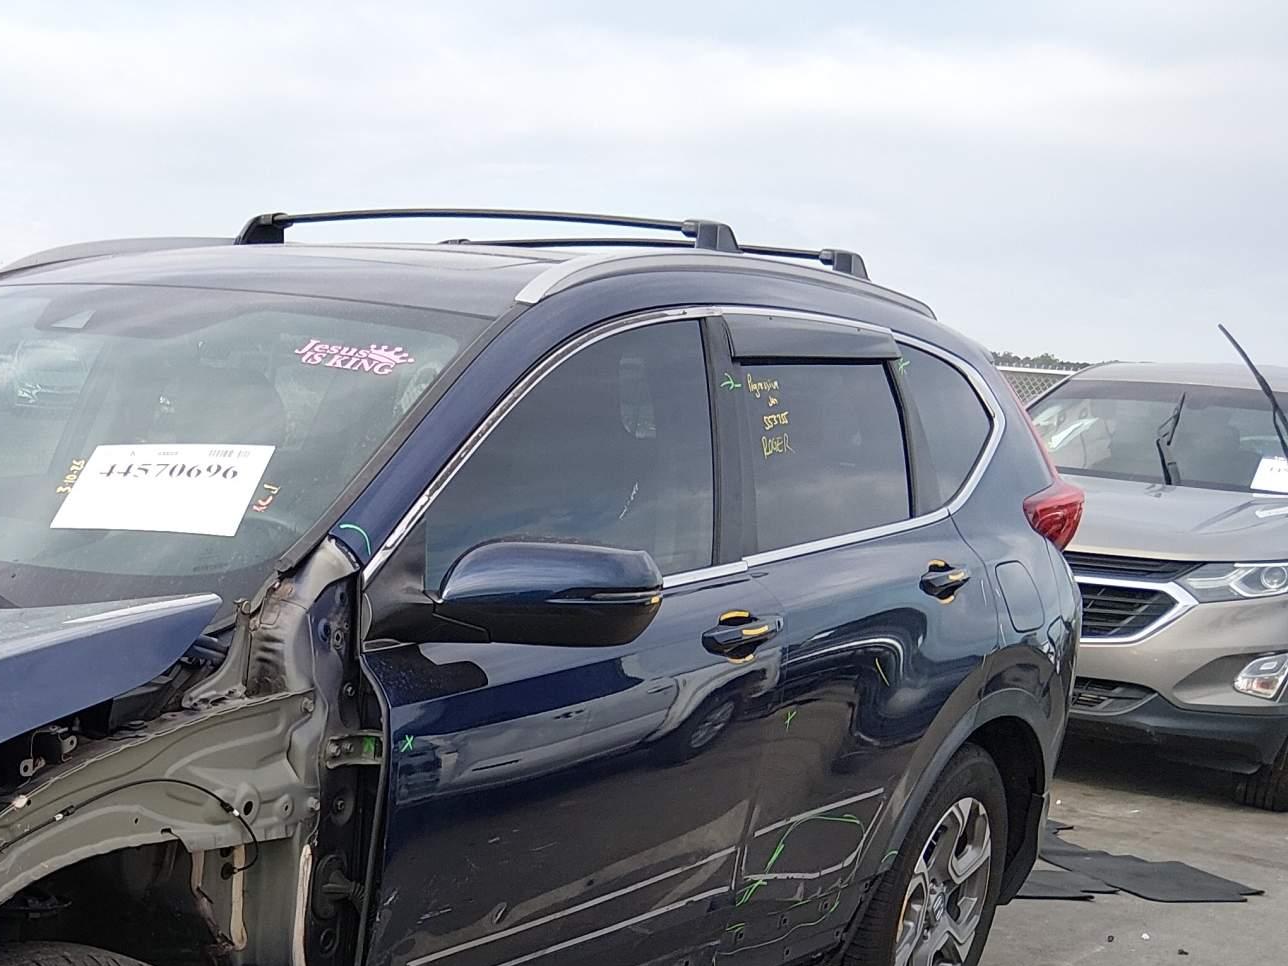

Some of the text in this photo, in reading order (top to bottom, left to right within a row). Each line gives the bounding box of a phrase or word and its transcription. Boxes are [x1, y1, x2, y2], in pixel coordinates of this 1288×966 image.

[294, 339, 370, 358] Jesus
[325, 354, 392, 375] KING
[99, 463, 239, 479] 44570696
